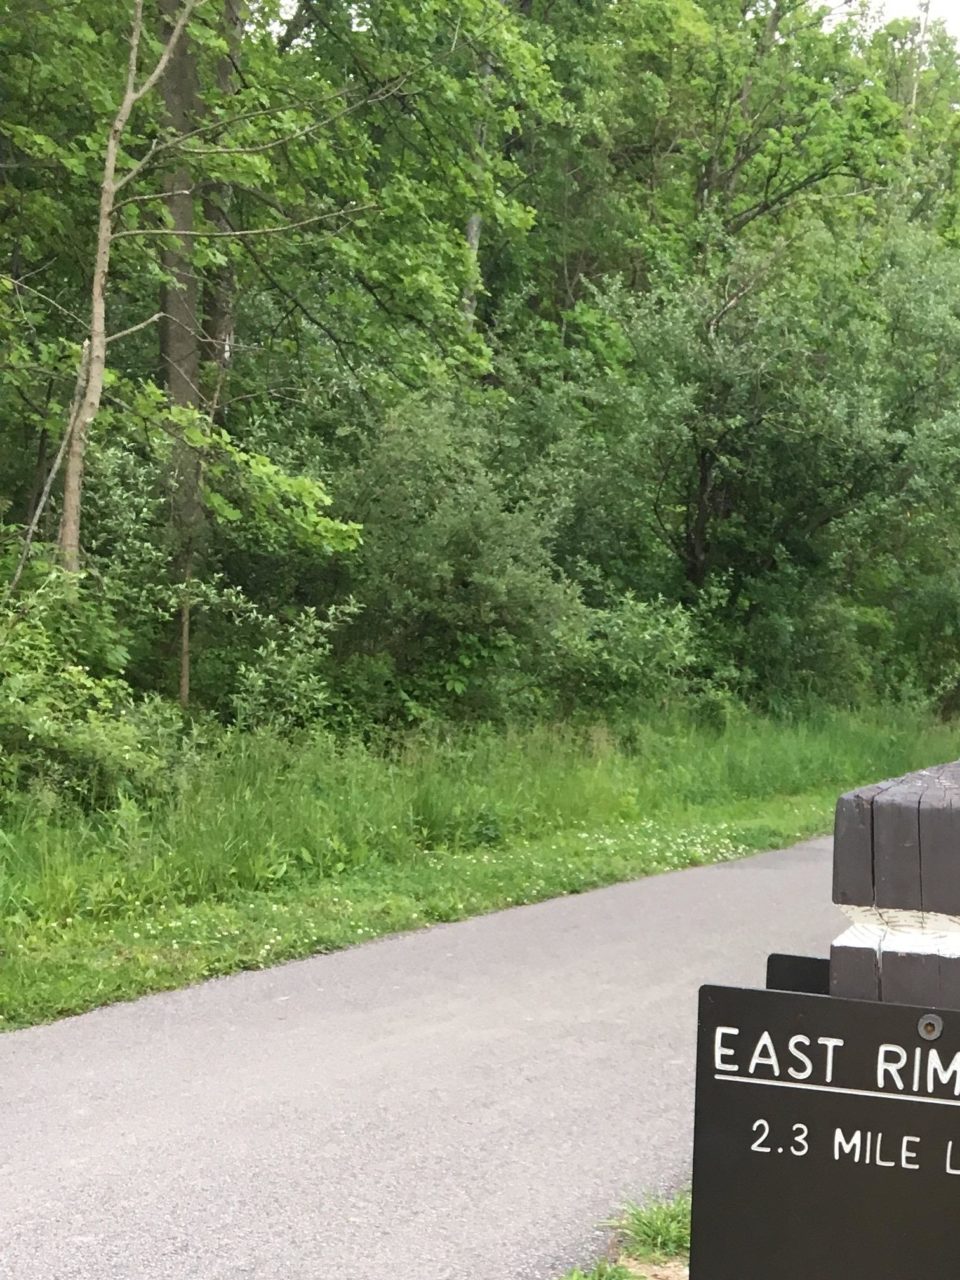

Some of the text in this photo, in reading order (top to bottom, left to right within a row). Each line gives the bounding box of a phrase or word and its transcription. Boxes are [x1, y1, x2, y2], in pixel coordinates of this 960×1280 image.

[714, 1026, 845, 1083] EAST
[750, 1118, 809, 1157] 2.3
[833, 1127, 921, 1170] MILE
